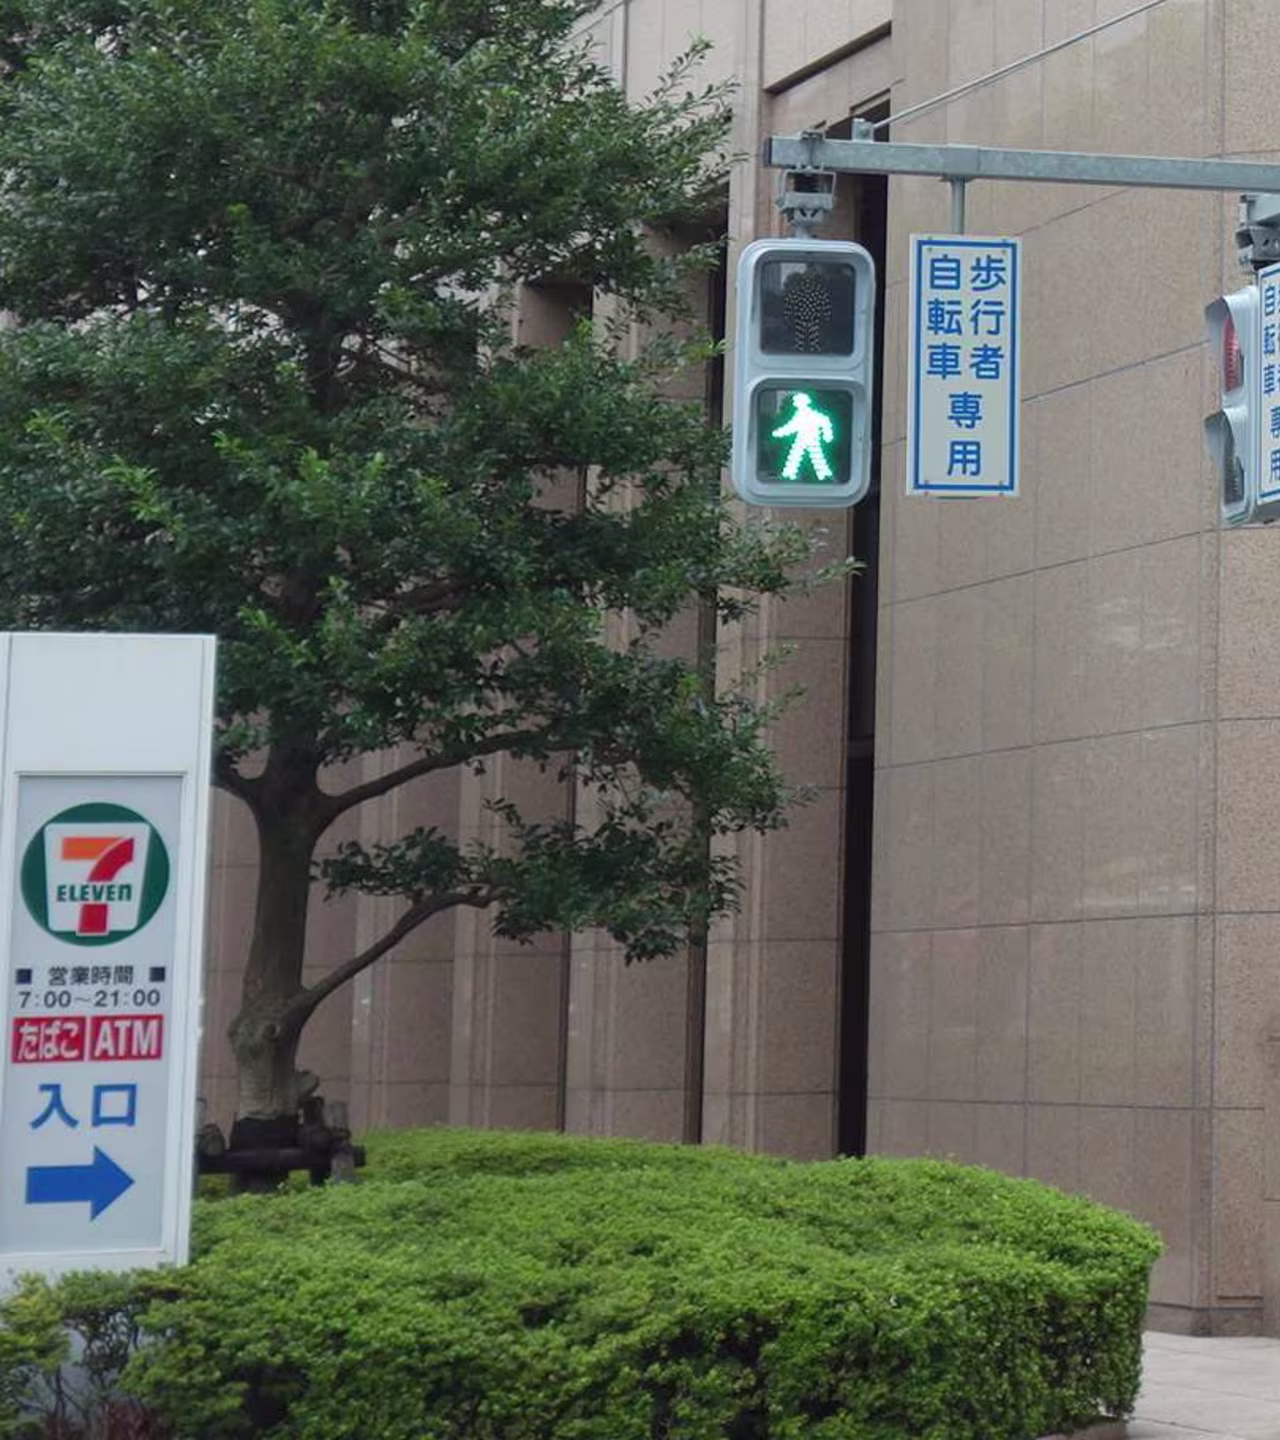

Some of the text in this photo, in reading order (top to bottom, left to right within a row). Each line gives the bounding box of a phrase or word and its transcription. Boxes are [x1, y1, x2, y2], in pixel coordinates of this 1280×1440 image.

[927, 254, 962, 380] 自転車
[969, 254, 1006, 380] 歩行者
[947, 391, 983, 477] 専用
[61, 837, 135, 934] 7
[49, 965, 134, 986] 営業時間
[18, 1021, 80, 1060] たばこ
[95, 1019, 159, 1057] ATM
[30, 1082, 138, 1130] 入口
